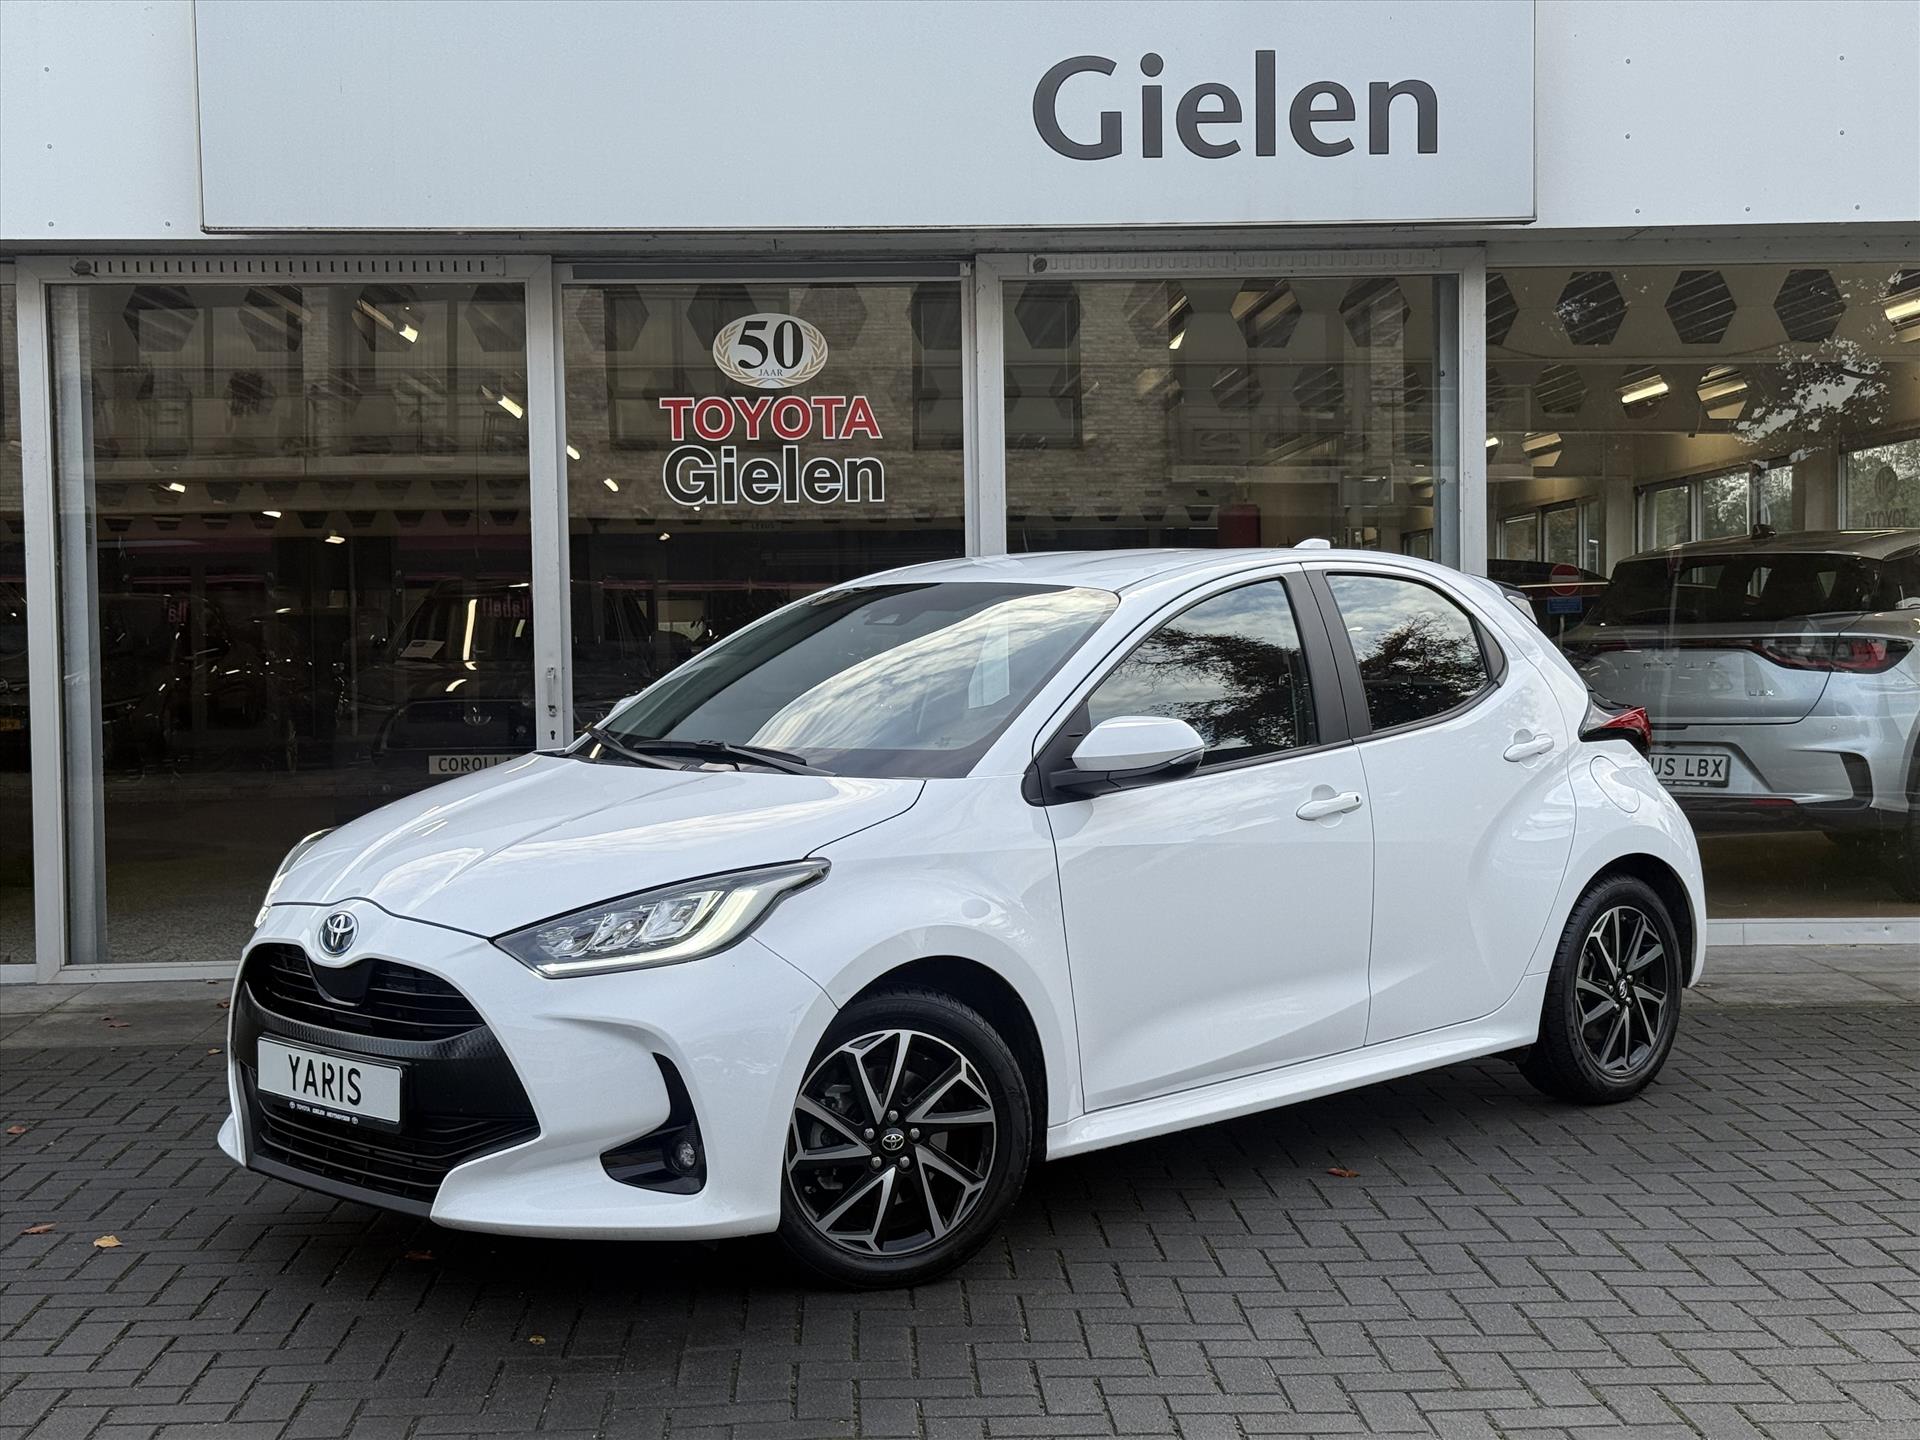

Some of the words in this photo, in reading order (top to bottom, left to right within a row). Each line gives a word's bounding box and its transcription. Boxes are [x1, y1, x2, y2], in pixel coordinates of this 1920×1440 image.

[1032, 49, 1439, 161] Gielen
[737, 319, 805, 370] 50
[758, 368, 784, 377] JAAR
[659, 395, 883, 442] TOYOTA
[662, 444, 886, 506] Gielen
[438, 757, 512, 772] COROL
[1684, 758, 1723, 778] LBX
[288, 1053, 362, 1106] YARIS
